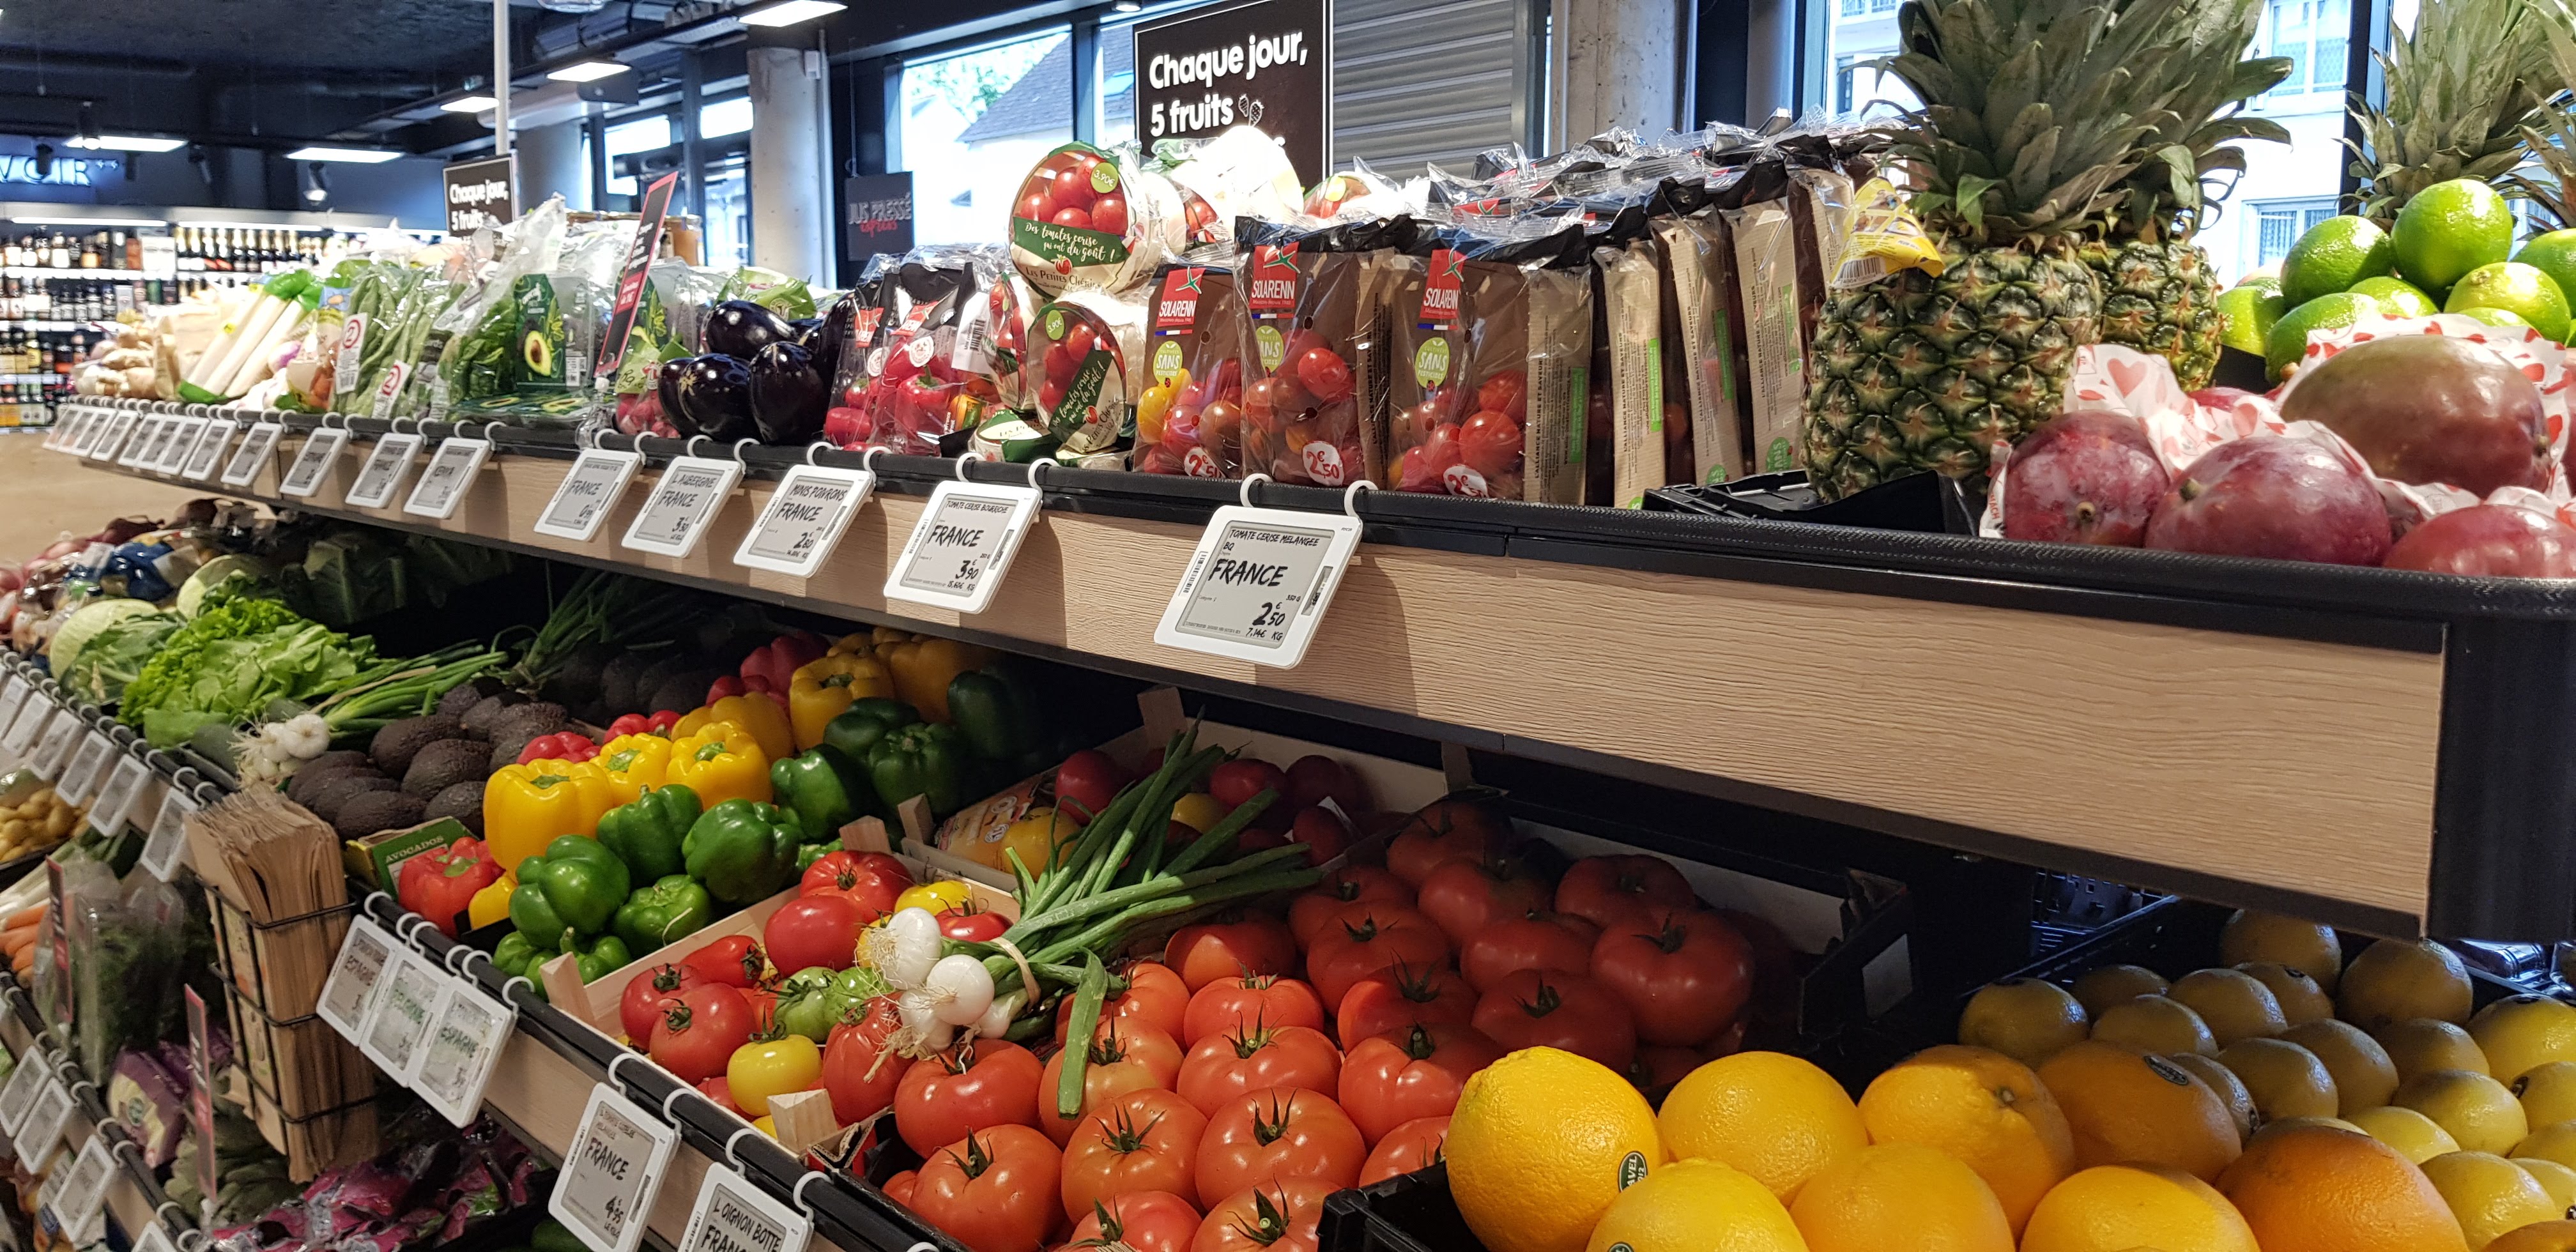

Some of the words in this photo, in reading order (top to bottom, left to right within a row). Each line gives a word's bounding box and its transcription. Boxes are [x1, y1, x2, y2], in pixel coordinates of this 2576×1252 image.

[1149, 45, 1244, 89] Chaque
[1246, 31, 1308, 80] jour,
[1151, 103, 1165, 137] 5
[1169, 93, 1234, 134] fruits
[1093, 170, 1116, 187] 3.90€
[451, 210, 459, 231] 5
[1025, 222, 1039, 234] Des
[1041, 224, 1073, 243] tomates
[1073, 234, 1098, 247] cerise
[1066, 241, 1081, 256] du
[1081, 247, 1107, 263] goût
[1251, 280, 1295, 300] SOLARENN
[1423, 287, 1459, 310] SOLARENN
[1159, 300, 1197, 317] SOLARENN
[1259, 341, 1280, 358] ANS
[1156, 355, 1180, 370] SANS
[1419, 352, 1448, 372] SANS
[1537, 393, 1542, 402] ET
[567, 480, 603, 496] FRANCE
[790, 484, 813, 497] MINIS
[809, 486, 848, 502] POIVRONS
[658, 490, 699, 508] FRANCE
[946, 500, 965, 509] TOMATE
[964, 502, 982, 511] CERISE
[775, 502, 823, 522] FRANCE
[793, 532, 808, 549] 2
[927, 524, 984, 548] FRANCE
[1229, 529, 1257, 540] TOMATE
[1256, 531, 1280, 542] CERISE
[1280, 534, 1320, 547] MELANGEE
[1223, 542, 1235, 551] BQ
[955, 560, 971, 579] 3
[965, 567, 979, 580] 90
[1208, 558, 1289, 586] FRANCE
[1252, 602, 1273, 626] 2
[1267, 612, 1285, 627] 50
[1246, 627, 1268, 638] 7,14€
[1271, 631, 1284, 641] KG
[385, 835, 445, 863] AVOCADOS
[584, 1136, 629, 1180] FRANCE
[1627, 1155, 1637, 1186] AVEL
[605, 1195, 618, 1219] 4
[712, 1196, 721, 1212] L
[721, 1202, 755, 1236] OIGNON
[752, 1222, 782, 1252] BOTTE
